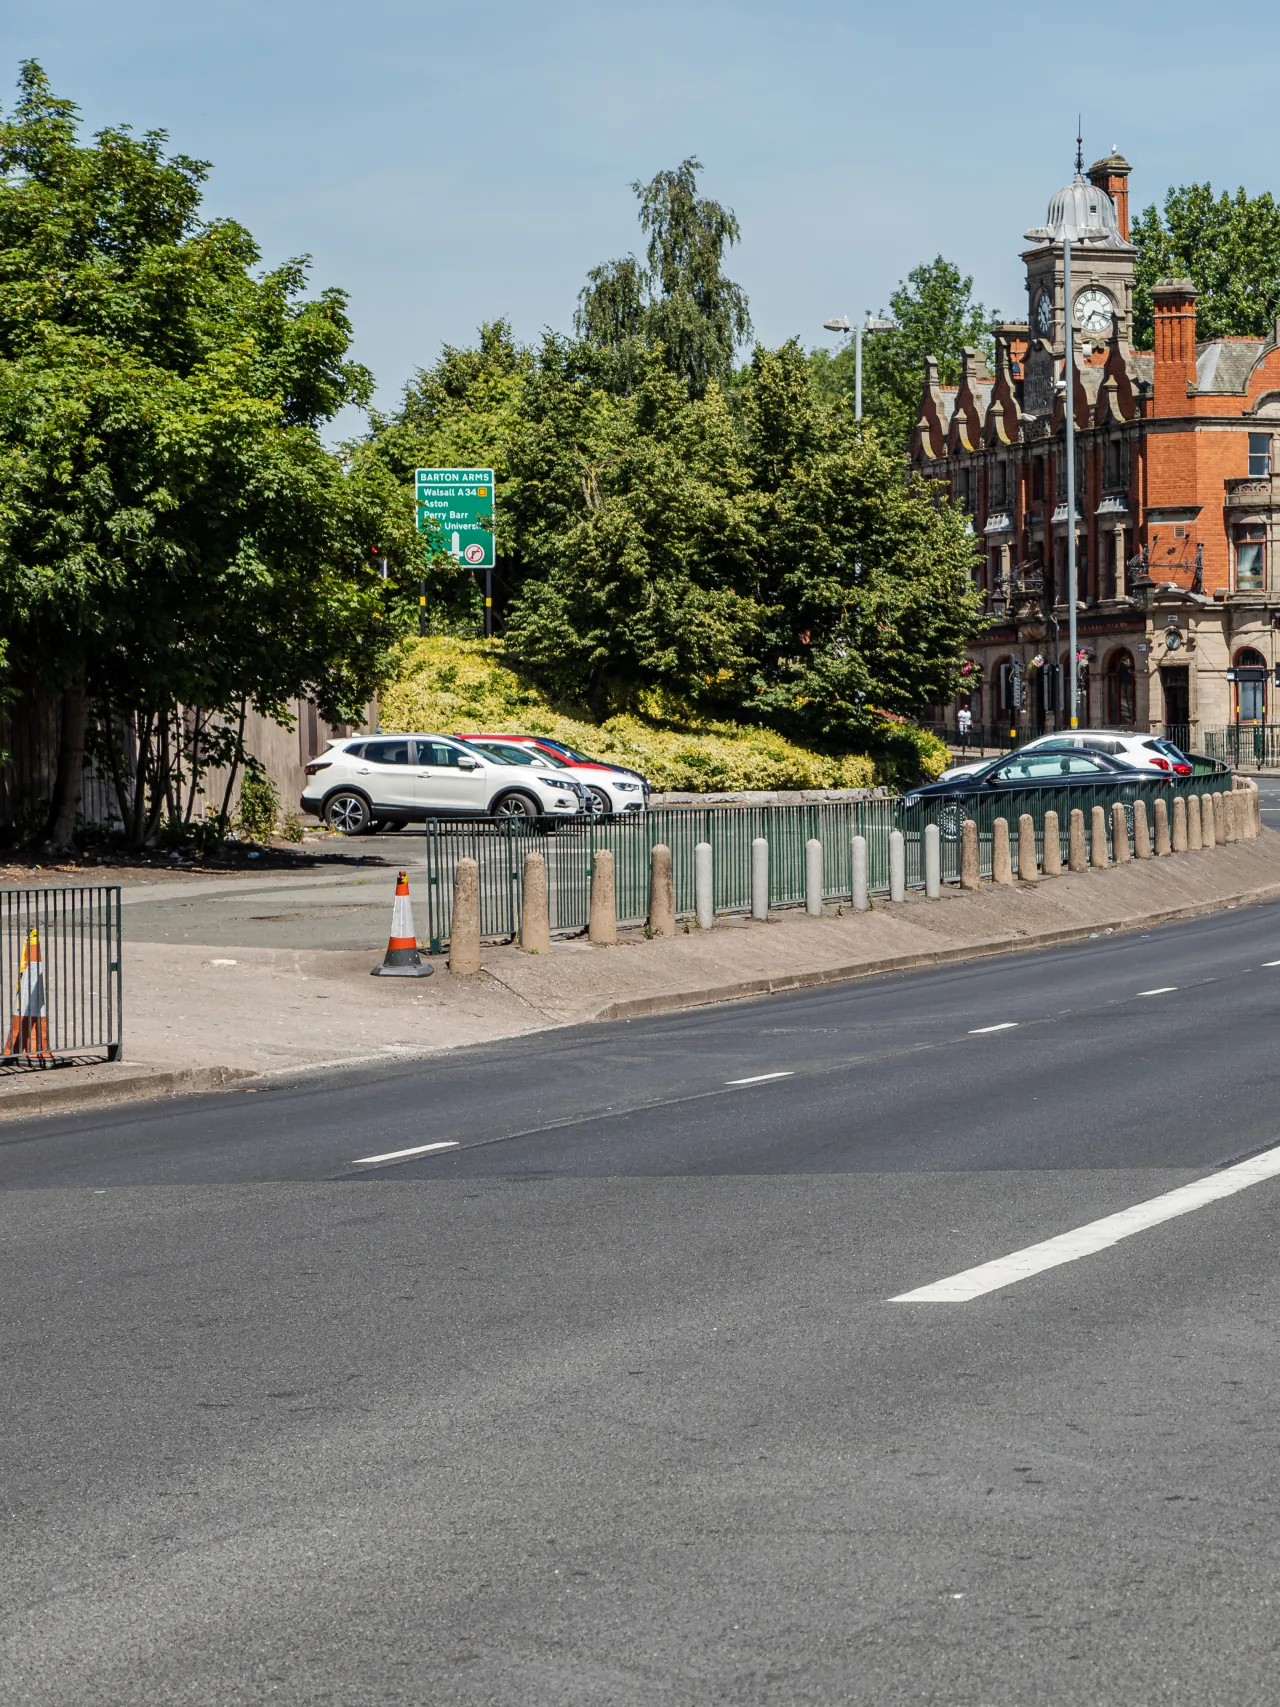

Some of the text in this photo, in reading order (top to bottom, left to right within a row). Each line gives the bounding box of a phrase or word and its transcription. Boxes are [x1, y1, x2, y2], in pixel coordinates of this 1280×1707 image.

[420, 473, 490, 481] BARTON ARMS
[423, 488, 455, 496] Walsall
[423, 511, 468, 520] Perry Barr
